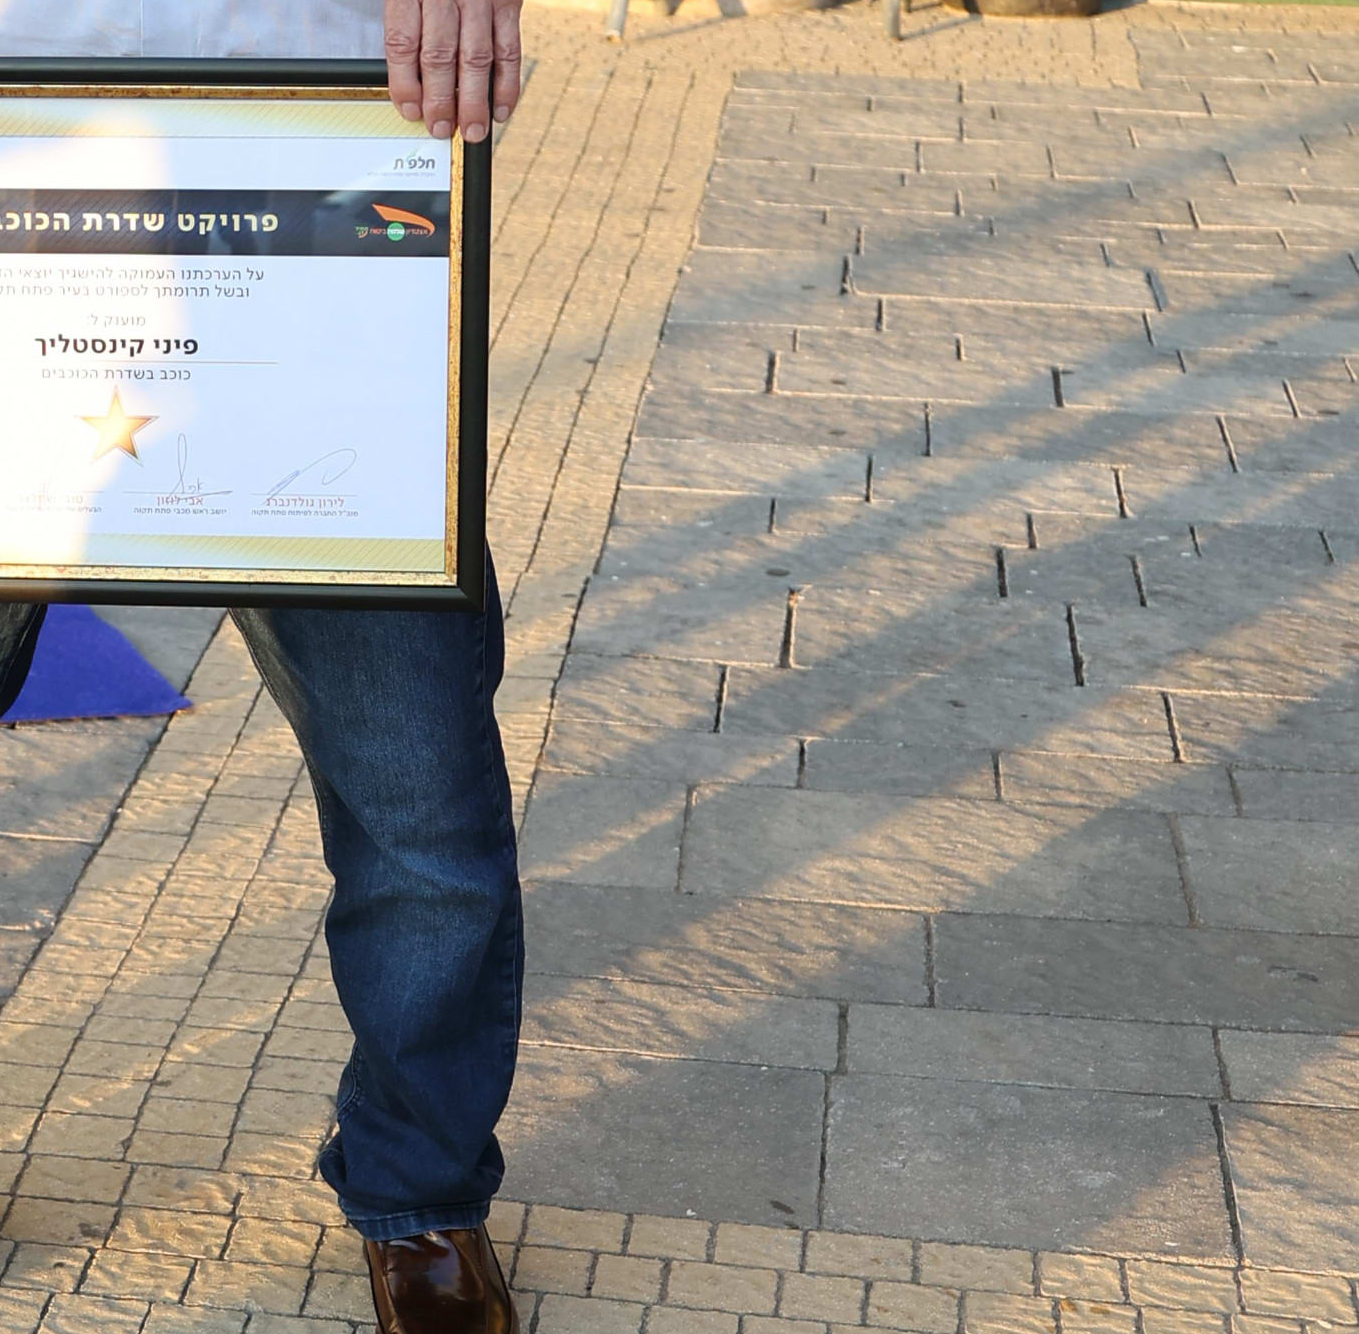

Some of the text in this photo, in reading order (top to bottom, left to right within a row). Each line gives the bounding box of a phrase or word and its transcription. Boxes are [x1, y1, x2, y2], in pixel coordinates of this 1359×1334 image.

[82, 212, 165, 231] שדרת
[177, 212, 279, 235] פרויקט
[19, 268, 52, 279] יוצאי
[118, 269, 175, 281] העמוקה
[181, 269, 241, 281] הערכתנו
[246, 267, 264, 281] על
[21, 285, 53, 296] פתח
[58, 286, 89, 296] בעיר
[96, 284, 148, 298] לספורט
[153, 286, 209, 299] תרומתך
[214, 284, 250, 298] ובשל
[104, 315, 146, 328] מוענק
[34, 333, 199, 358] פיני קינסטליך
[41, 368, 191, 381] כוכב בשדרת הכוכבים
[318, 496, 345, 508] לירון
